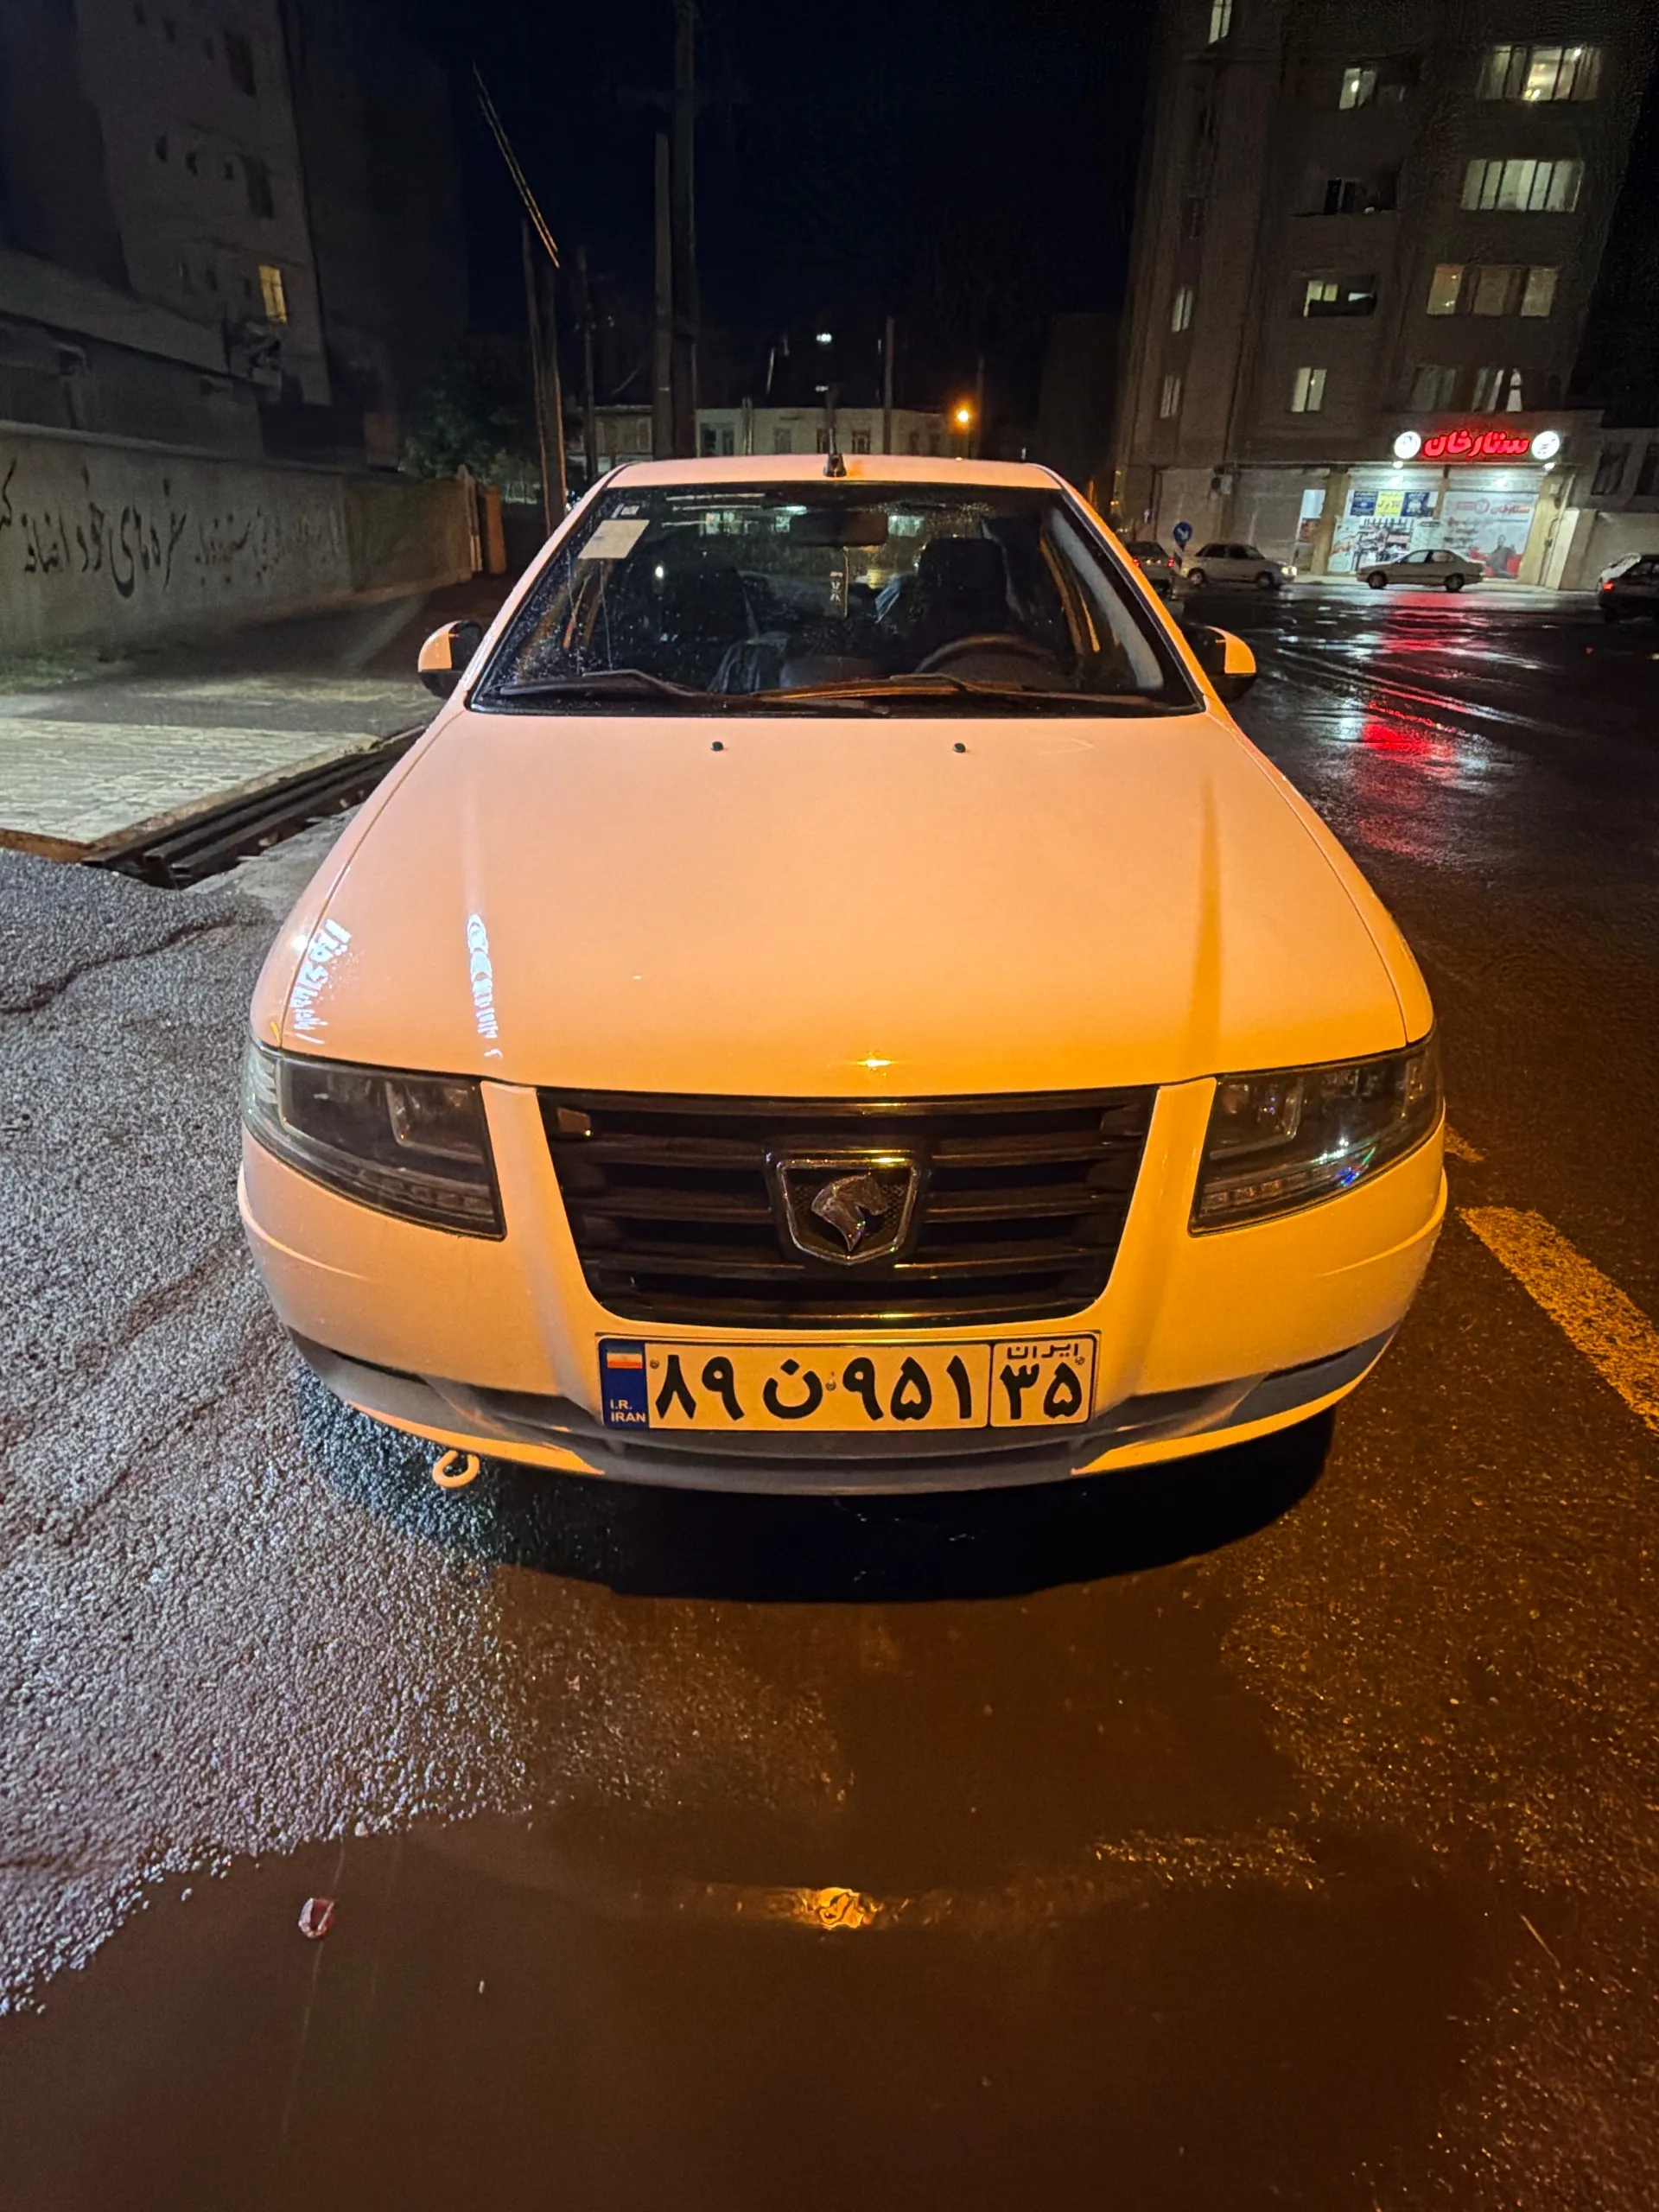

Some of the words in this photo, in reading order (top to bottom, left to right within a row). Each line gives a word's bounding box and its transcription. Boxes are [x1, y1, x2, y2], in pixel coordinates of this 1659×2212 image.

[1422, 429, 1531, 458] ستارخان
[1007, 1343, 1078, 1359] ایران
[655, 1354, 745, 1421] ۸۹
[763, 1358, 823, 1420] ن
[842, 1354, 972, 1421] ۹۵۱
[1000, 1362, 1083, 1420] ۳۵
[610, 1399, 632, 1410] I.R.
[611, 1411, 646, 1422] IRAN
